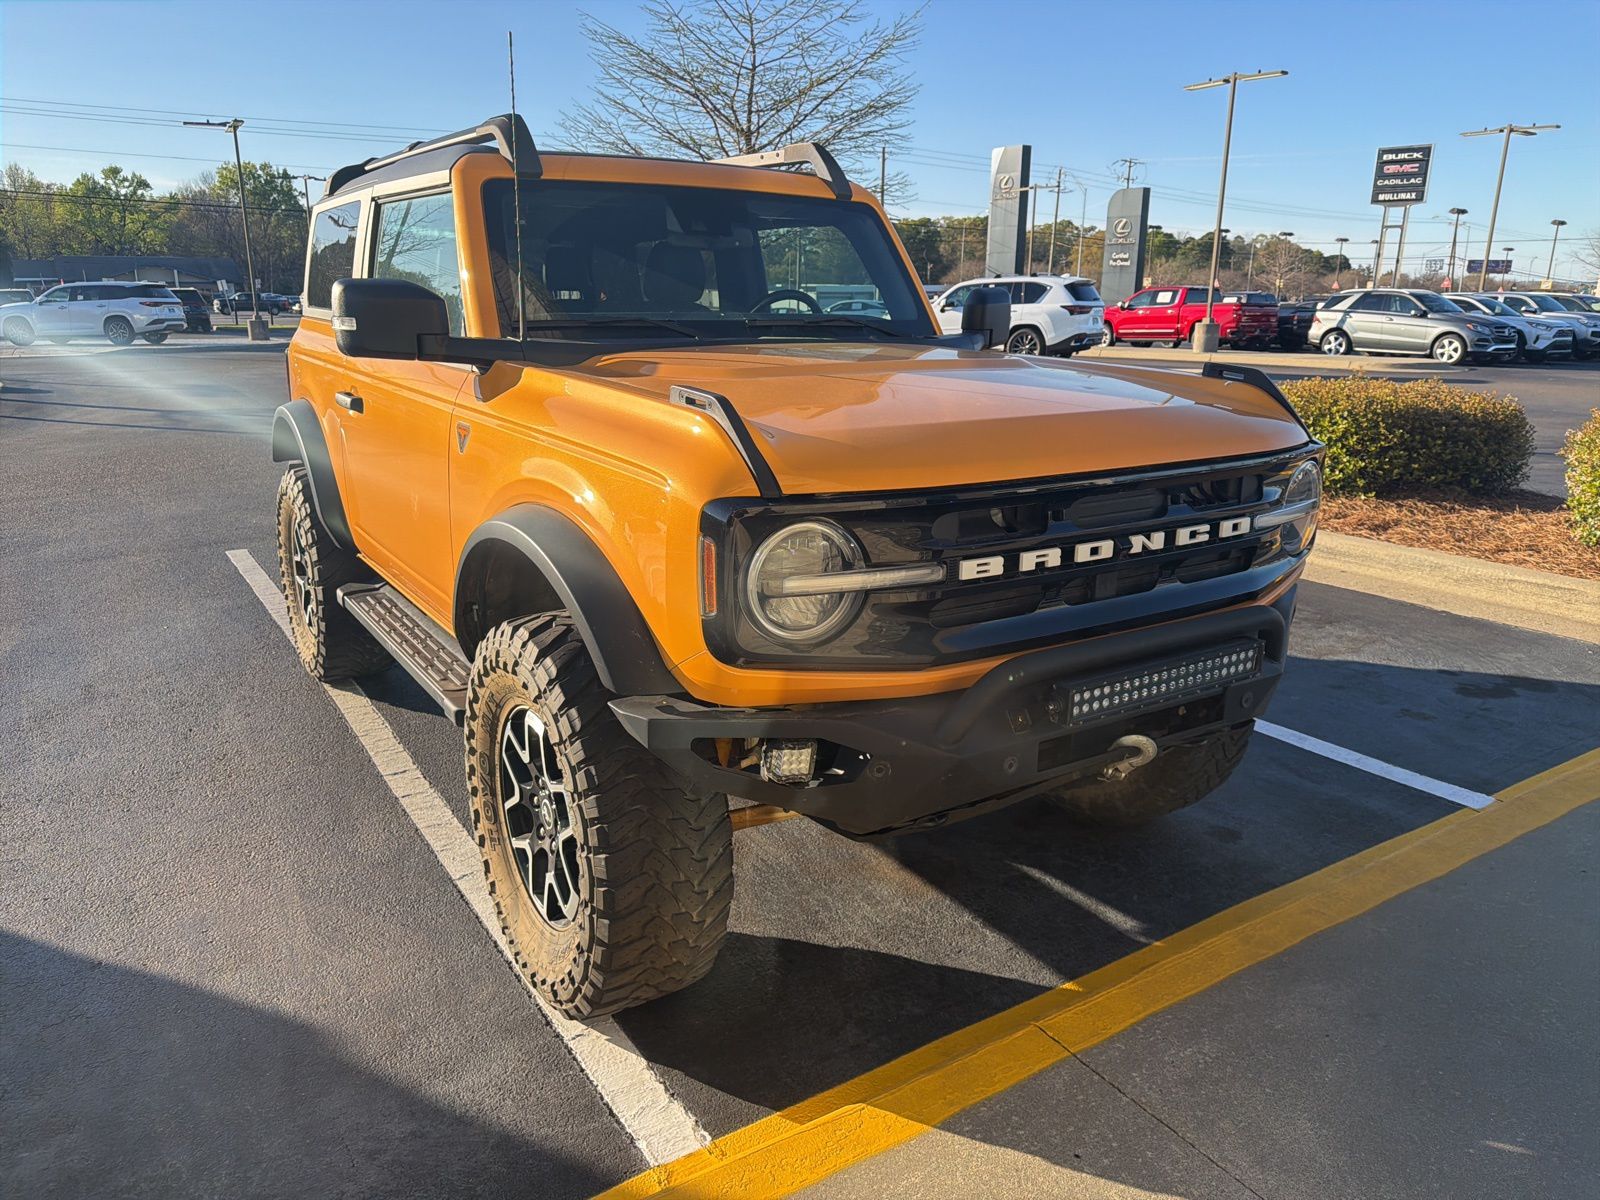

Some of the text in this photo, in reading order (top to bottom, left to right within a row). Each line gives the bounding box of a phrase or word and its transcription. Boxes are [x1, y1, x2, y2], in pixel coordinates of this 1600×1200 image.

[1382, 152, 1424, 160] BUICK
[1383, 163, 1420, 173] GMC
[1376, 177, 1423, 186] CADILLAC
[1378, 192, 1417, 201] MULLINAX
[1107, 237, 1136, 245] LEXUS
[959, 517, 1251, 581] BRONCO
